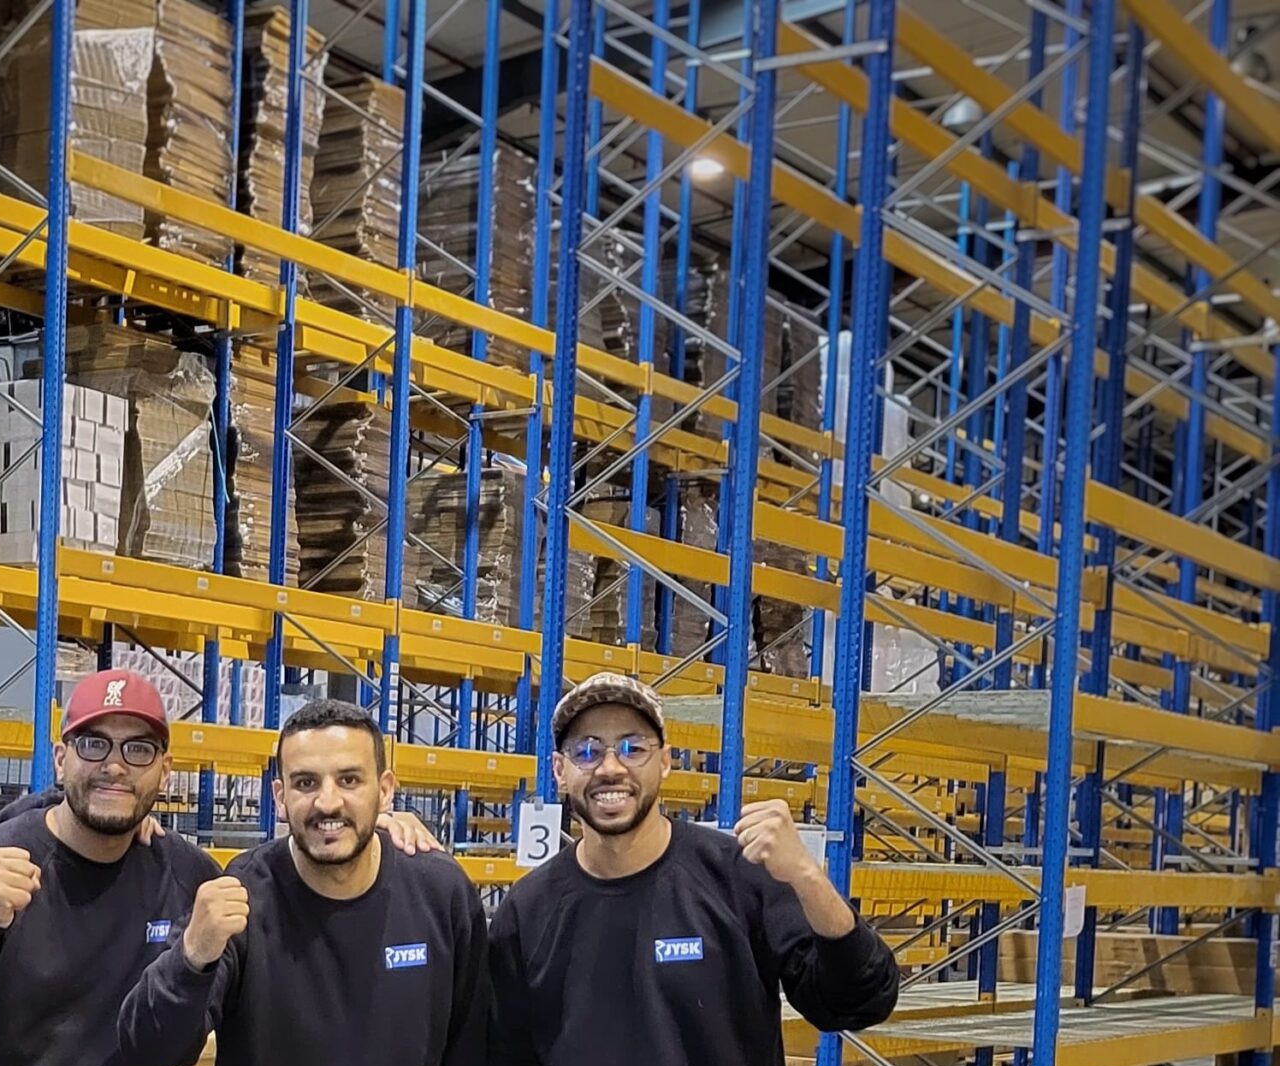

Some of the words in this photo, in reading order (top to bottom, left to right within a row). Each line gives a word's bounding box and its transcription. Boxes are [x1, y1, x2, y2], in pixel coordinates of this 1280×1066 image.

[528, 825, 550, 860] 3
[393, 948, 426, 963] JYSK
[664, 942, 701, 956] JYSK
